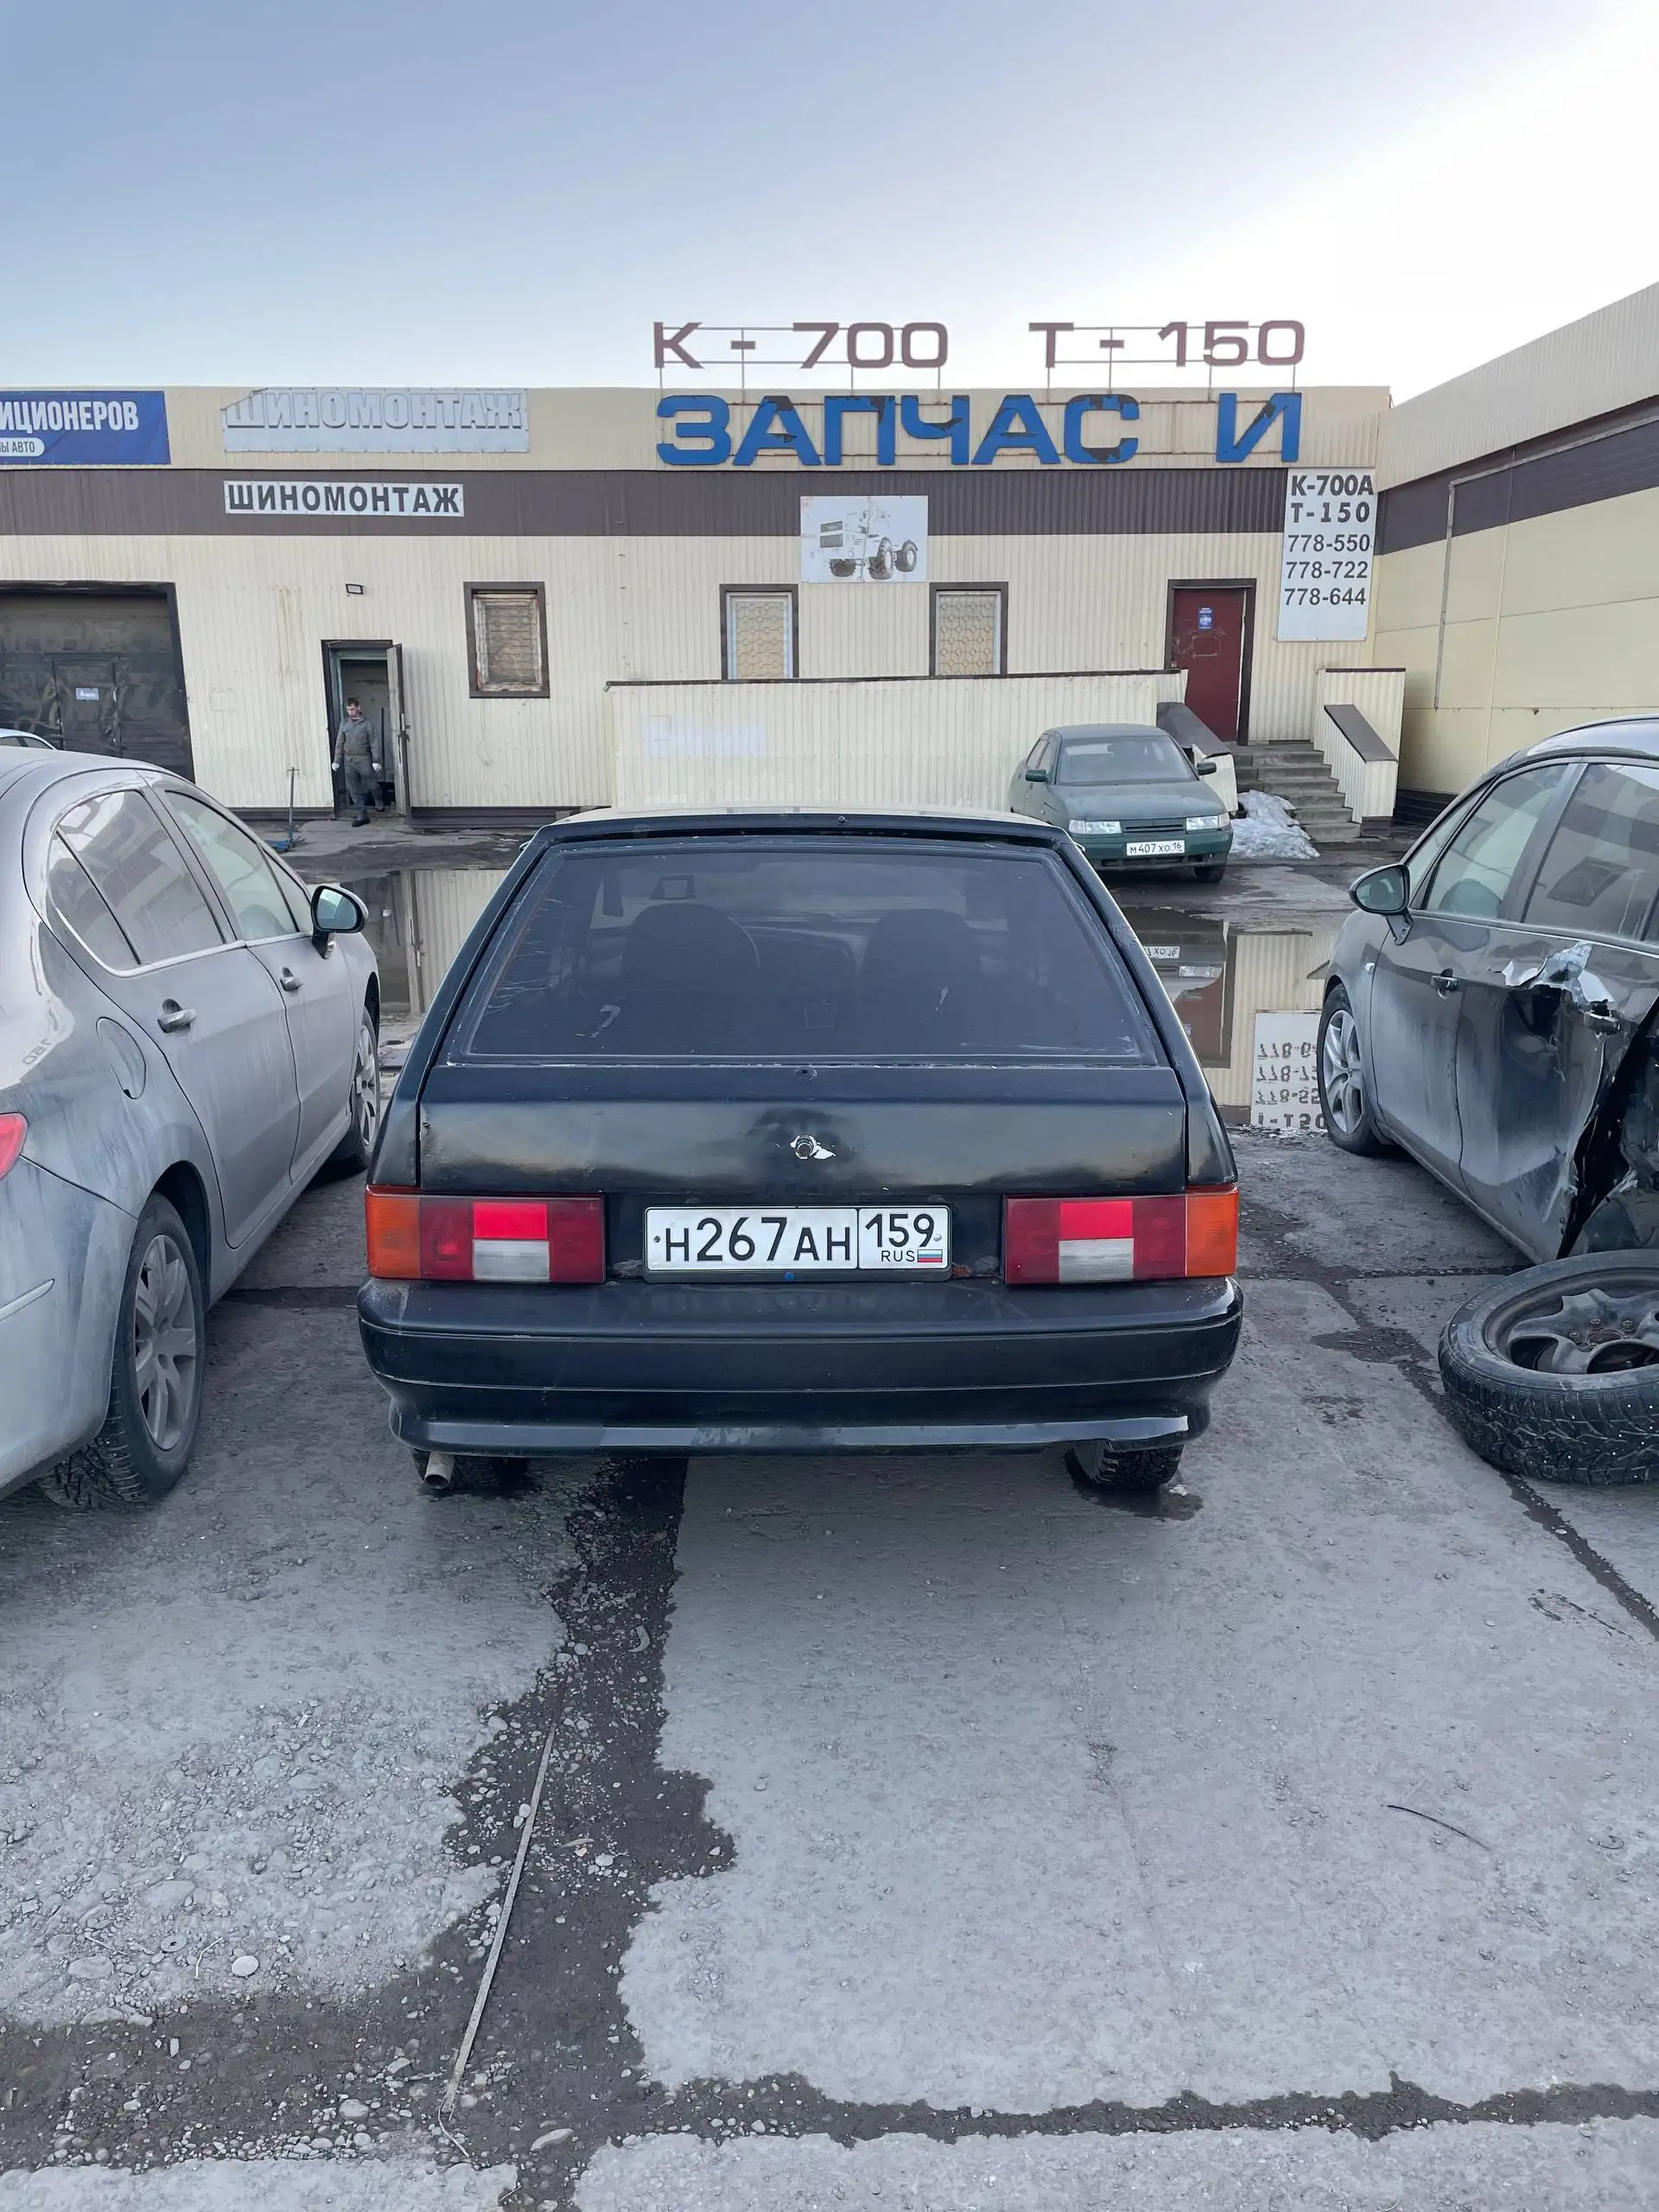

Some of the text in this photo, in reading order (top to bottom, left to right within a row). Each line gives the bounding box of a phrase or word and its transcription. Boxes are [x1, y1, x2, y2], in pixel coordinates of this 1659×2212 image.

[226, 392, 524, 429] ШИНОМОНТАЖ
[12, 442, 35, 453] АВТО
[1291, 474, 1374, 496] К-700А
[227, 484, 460, 513] ШИНОМОНТАЖ
[1287, 534, 1370, 552] 778-550
[1286, 561, 1368, 579] 778-722
[1284, 588, 1366, 606] 778-644
[665, 1213, 935, 1262] Н267АН 159
[881, 1250, 915, 1262] RUS
